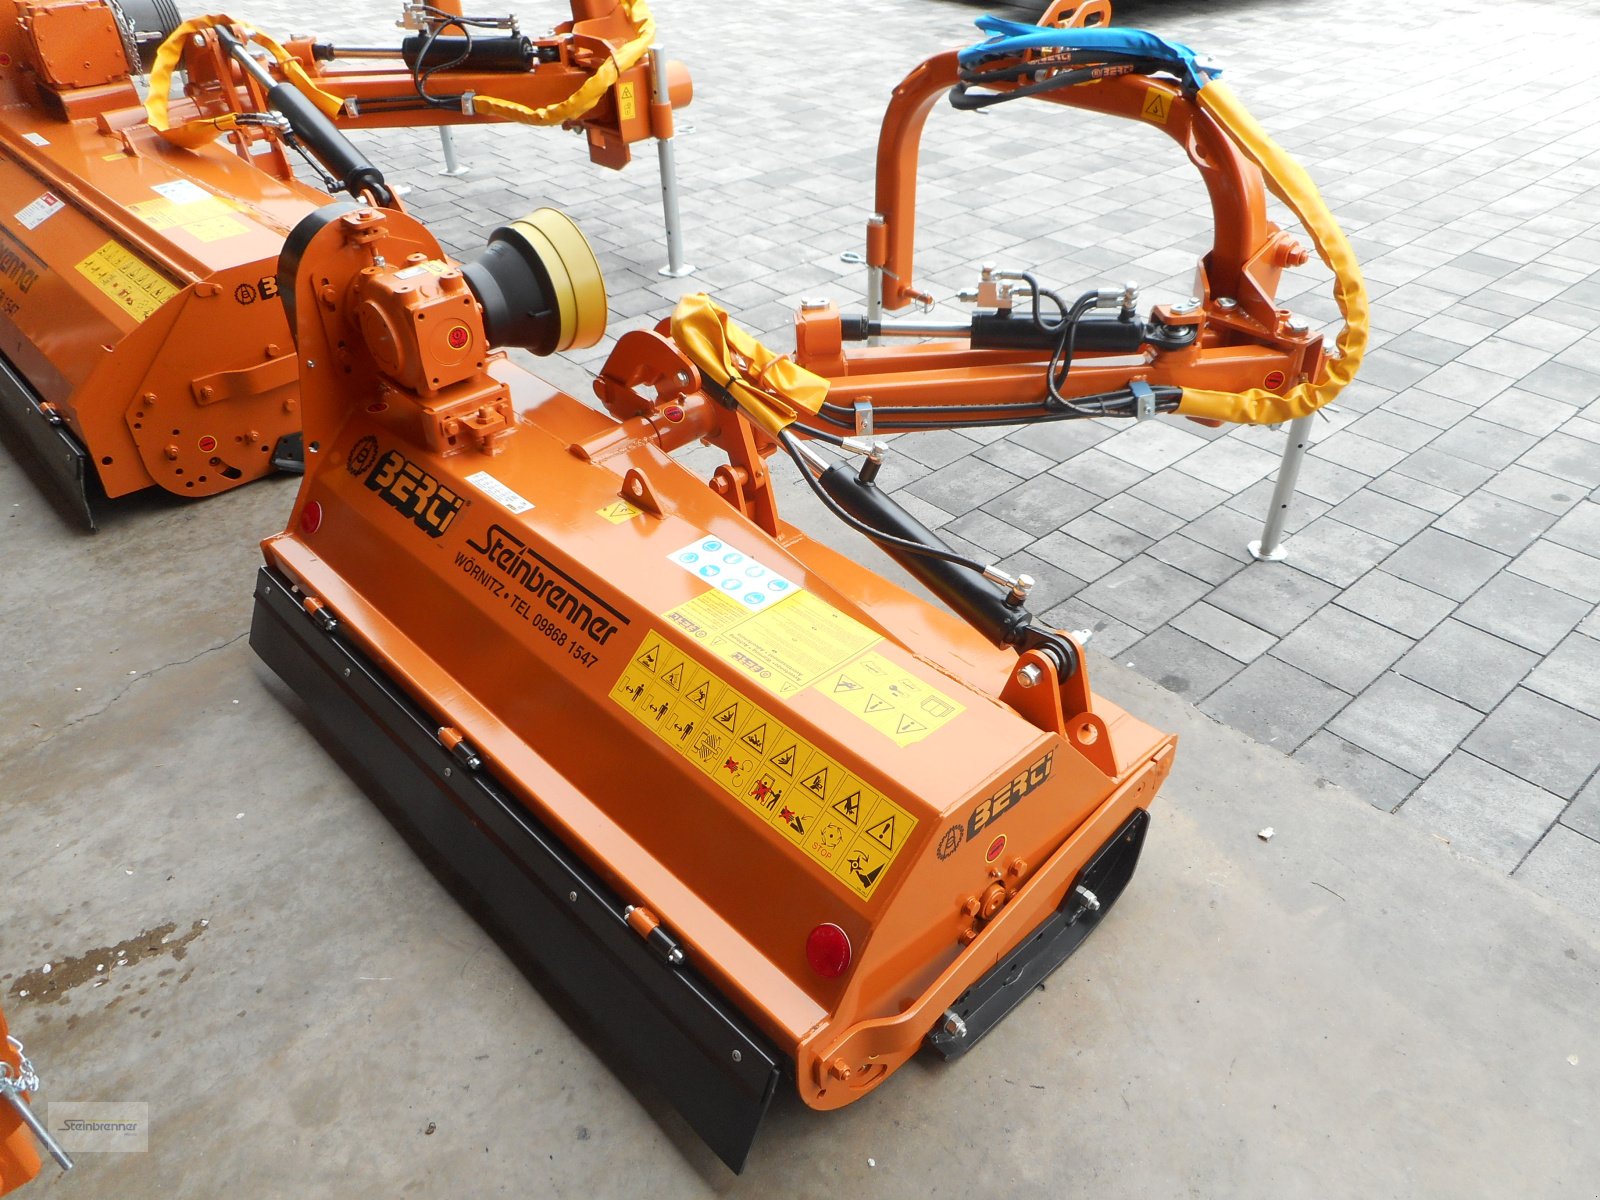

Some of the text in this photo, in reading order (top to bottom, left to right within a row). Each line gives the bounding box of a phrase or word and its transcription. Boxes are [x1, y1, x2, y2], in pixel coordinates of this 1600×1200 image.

[454, 551, 599, 670] WÖRNITZ TEL 09868 1547
[465, 523, 631, 646] Steinbrenner
[811, 841, 833, 860] STOP
